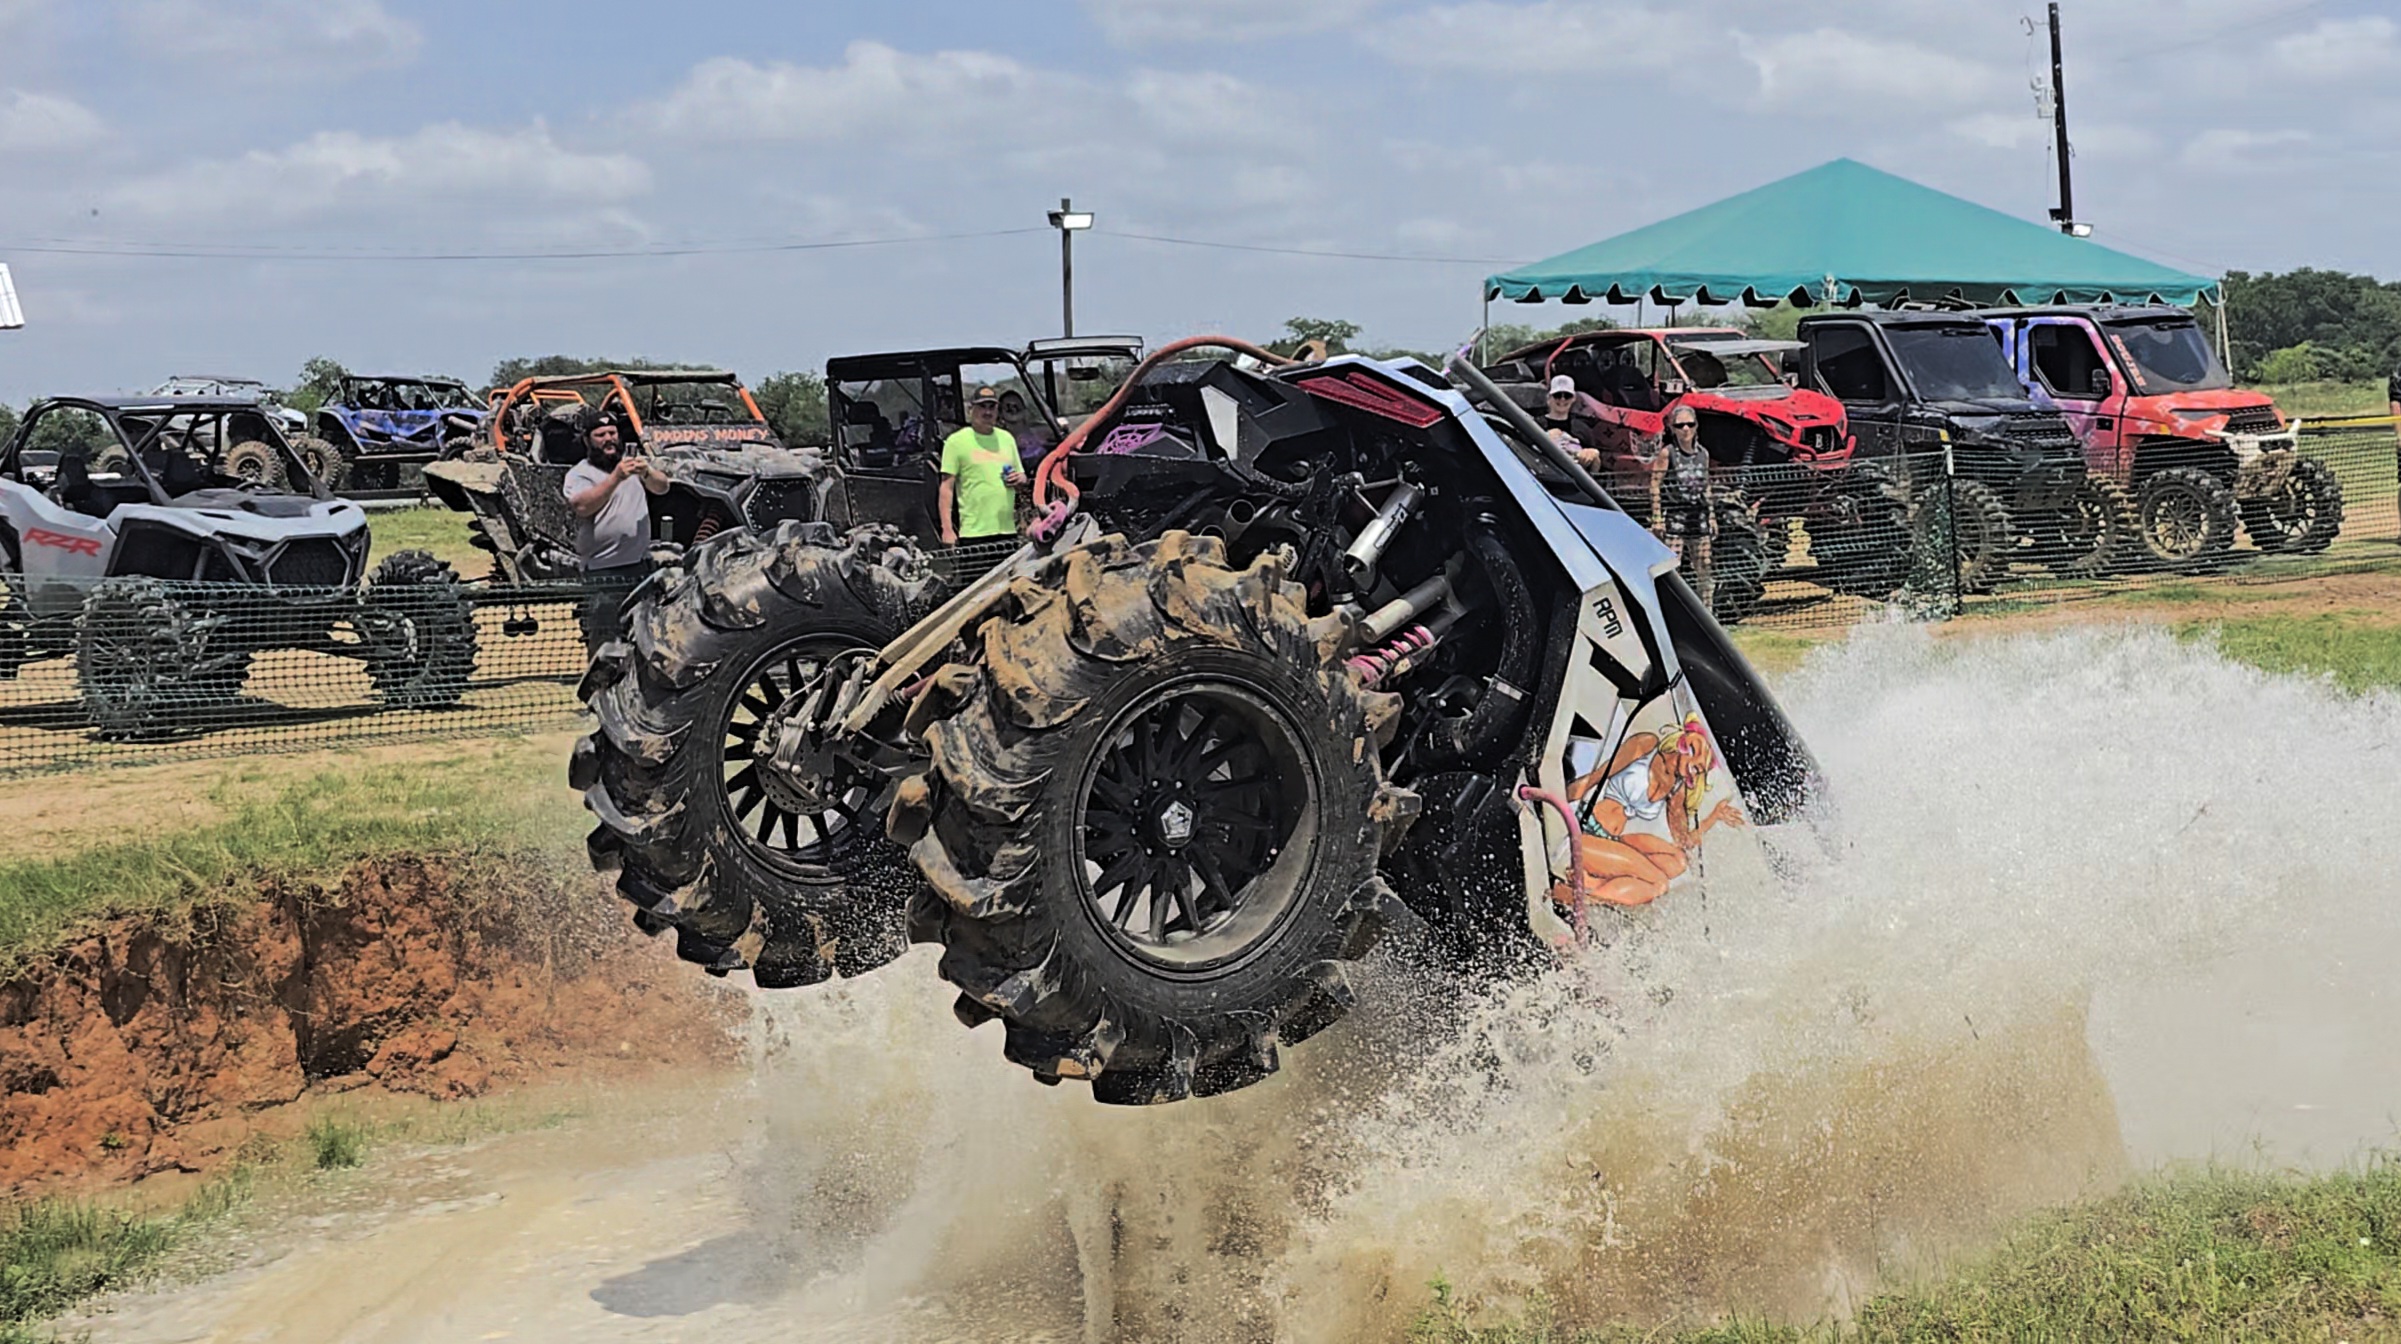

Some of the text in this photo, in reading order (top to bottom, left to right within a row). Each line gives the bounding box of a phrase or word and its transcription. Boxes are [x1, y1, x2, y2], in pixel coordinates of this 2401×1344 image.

[714, 427, 769, 441] MONEY
[23, 527, 103, 558] RZR
[1592, 597, 1624, 640] RPM
